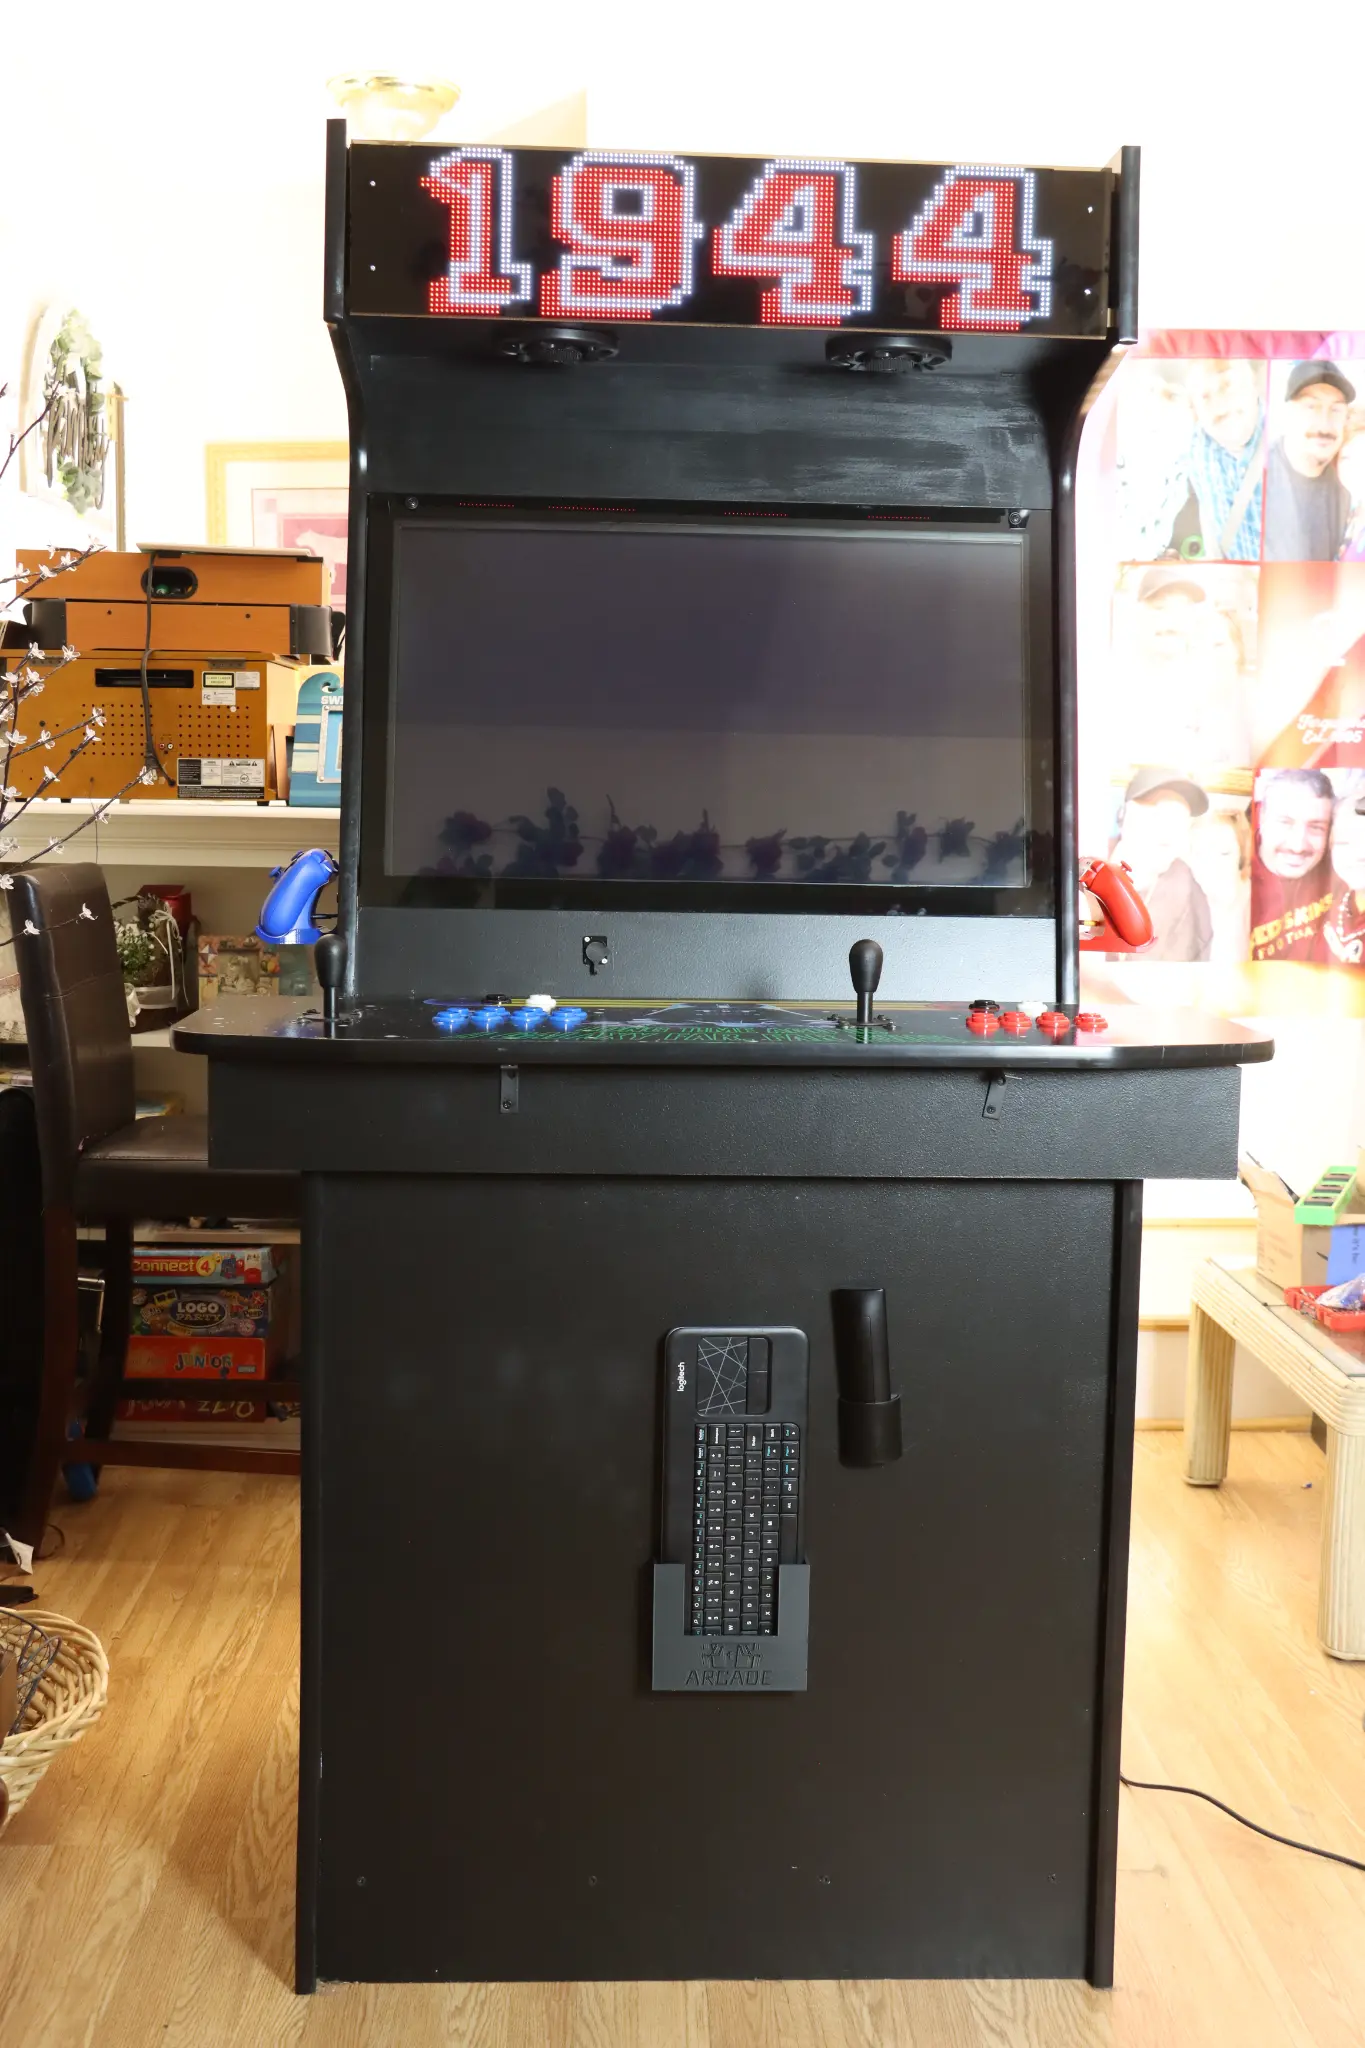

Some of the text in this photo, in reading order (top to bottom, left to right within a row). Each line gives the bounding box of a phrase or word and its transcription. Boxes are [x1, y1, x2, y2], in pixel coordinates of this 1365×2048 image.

[420, 146, 1054, 330] 1944
[200, 1259, 212, 1273] 4
[177, 1301, 219, 1314] LOGO
[175, 1312, 223, 1322] PARTY
[174, 1351, 234, 1372] JUNIOR
[676, 1361, 687, 1392] logitech
[685, 1669, 772, 1686] ARCADE
